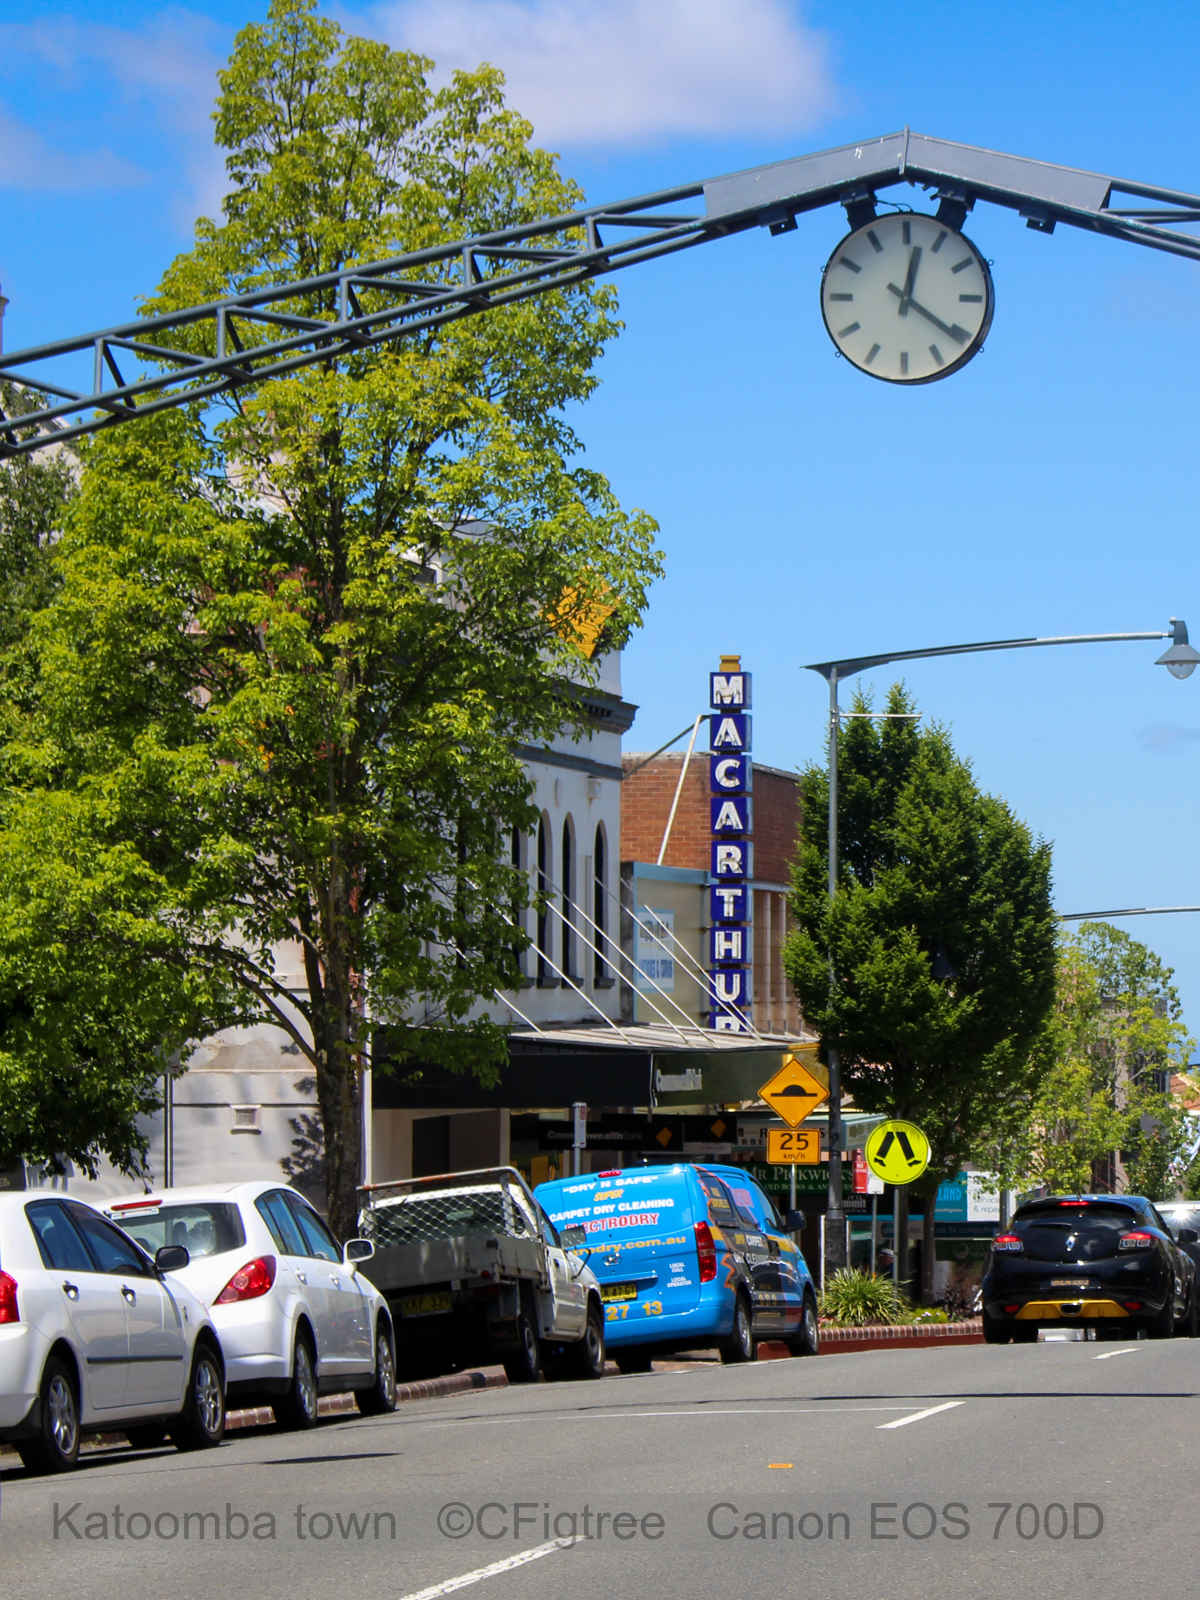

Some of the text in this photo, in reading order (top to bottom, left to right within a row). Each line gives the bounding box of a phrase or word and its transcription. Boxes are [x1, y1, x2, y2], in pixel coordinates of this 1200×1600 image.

[780, 1133, 809, 1150] 25
[601, 1180, 611, 1188] N
[549, 1198, 675, 1222] CARPET DRY CLEANING
[565, 1213, 659, 1234] ECTRODRY
[606, 1301, 663, 1320] 27 13
